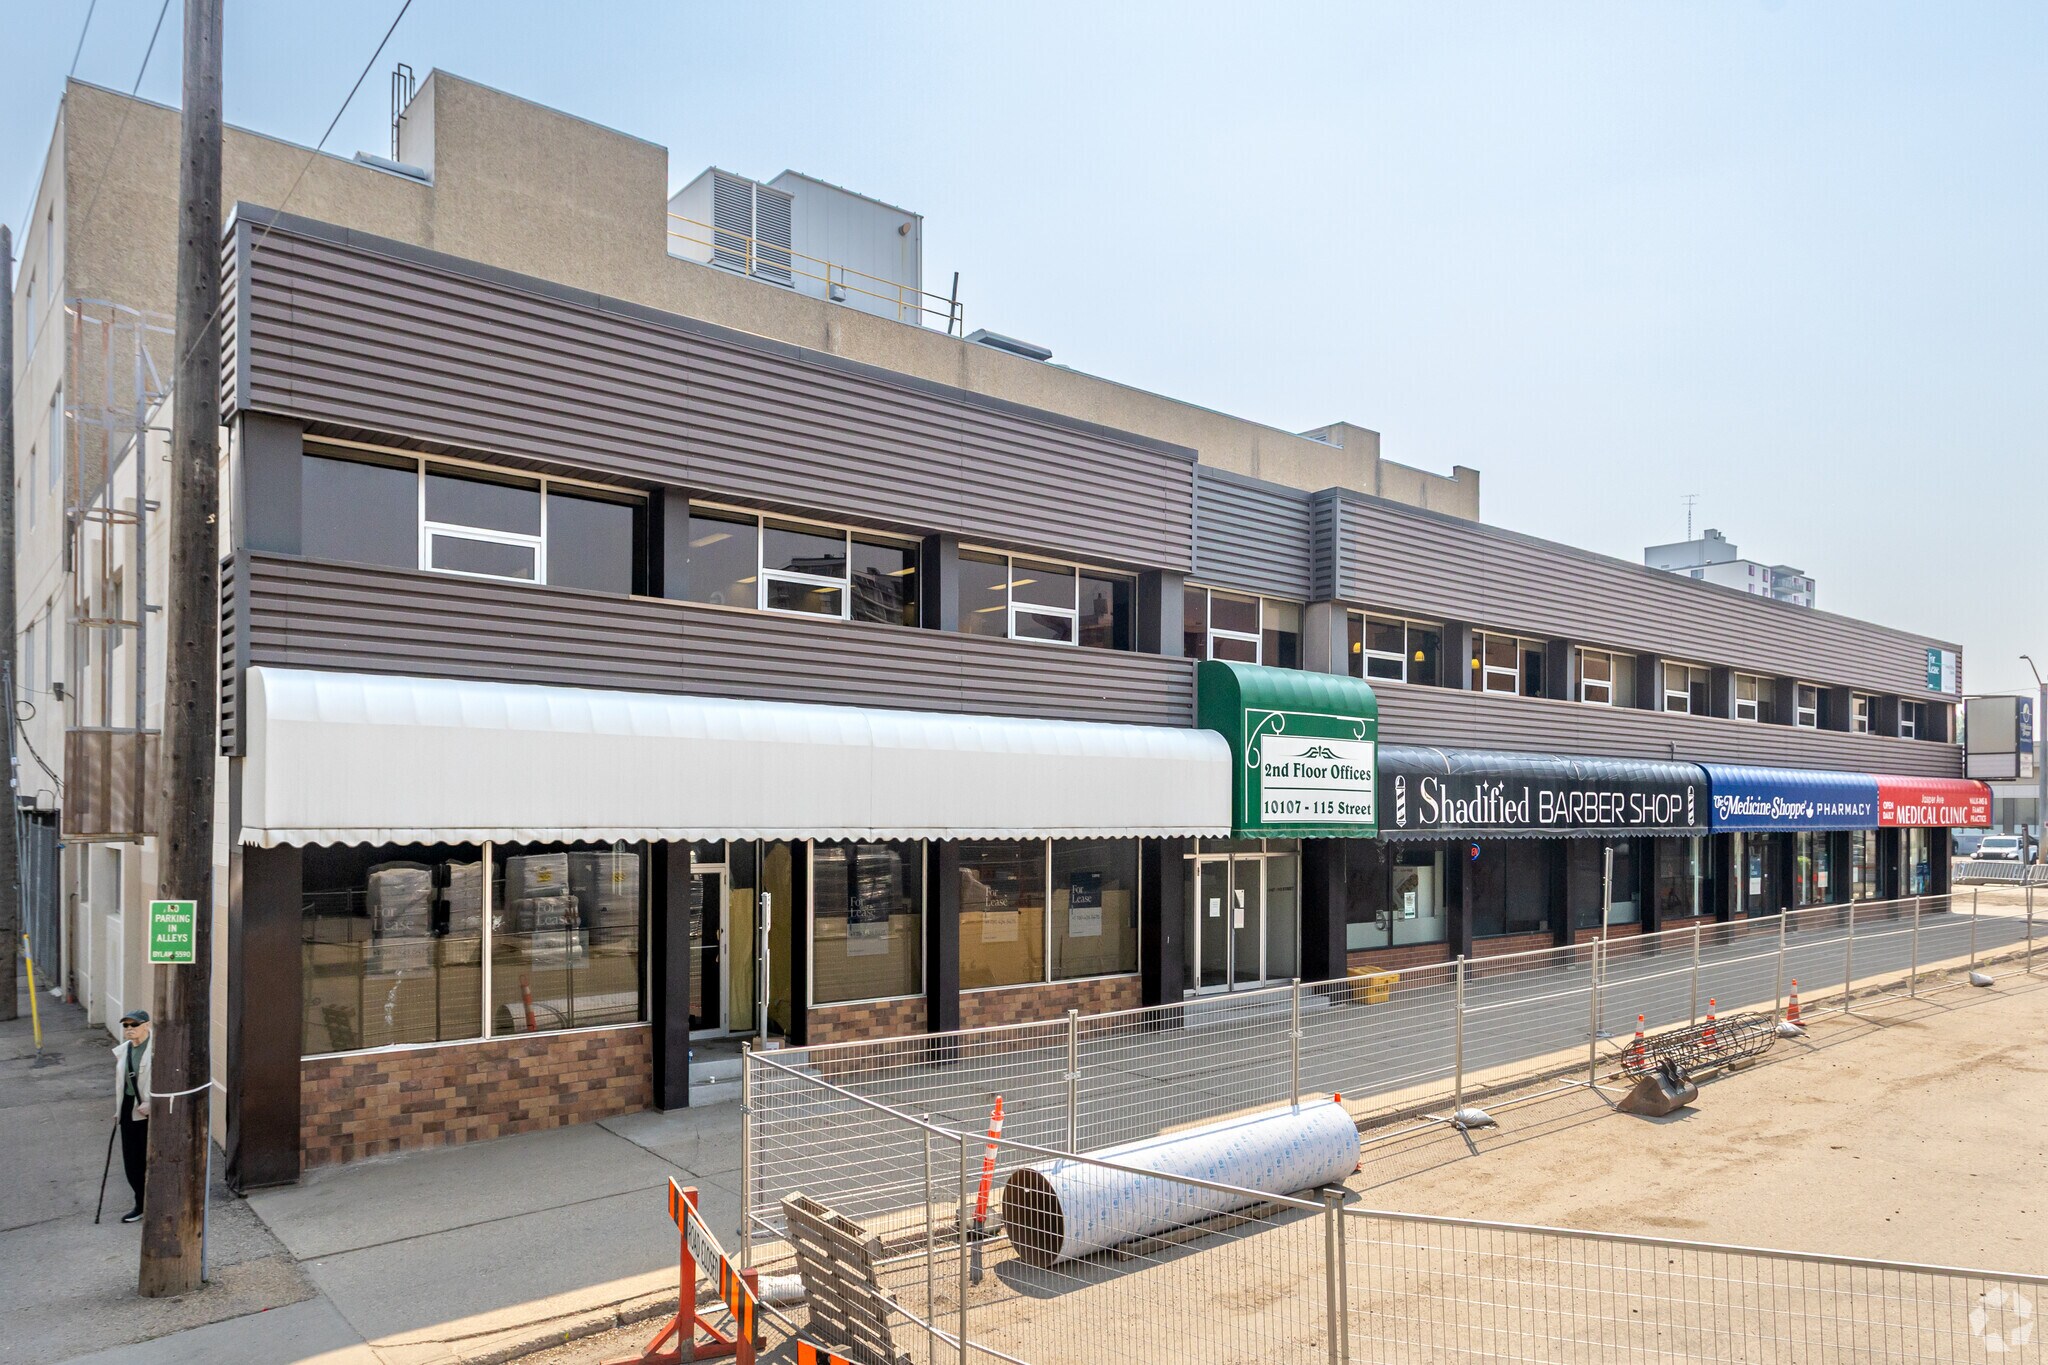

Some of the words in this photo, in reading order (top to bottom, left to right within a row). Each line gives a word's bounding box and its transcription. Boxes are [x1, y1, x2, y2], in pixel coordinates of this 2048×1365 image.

[1264, 762, 1289, 778] 2nd
[1293, 763, 1328, 779] Floor
[1330, 764, 1372, 781] Offices
[1419, 776, 1530, 824] Shadified
[1538, 790, 1625, 824] BARBER
[1629, 792, 1683, 824] SHOP
[1921, 794, 1936, 805] Jasper
[1936, 795, 1945, 804] Ave
[1264, 800, 1301, 814] 10107
[1313, 801, 1334, 814] 115
[1337, 801, 1372, 816] Street
[1713, 795, 1724, 808] The
[1719, 795, 1771, 820] Medicine
[1771, 796, 1807, 819] Shoppe
[1816, 802, 1871, 816] PHARMACY
[1882, 801, 1894, 810] OPEN
[1971, 806, 1985, 814] FAMILY
[1882, 811, 1894, 820] DAILY
[1896, 805, 1938, 825] MEDICAL
[1939, 806, 1968, 824] CLINIC
[1970, 815, 1987, 823] PRACTICE
[985, 886, 999, 897] For
[1072, 884, 1084, 894] For
[850, 896, 865, 907] For
[985, 897, 1008, 907] Lease
[1072, 894, 1092, 904] Lease
[167, 904, 180, 913] NO
[374, 905, 398, 918] For
[537, 900, 556, 913] For
[155, 914, 191, 923] PARKING
[167, 924, 178, 933] IN
[374, 918, 415, 931] Lease
[156, 933, 188, 943] ALLEYS
[152, 950, 173, 958] BYLAW
[688, 1220, 701, 1259] ROAD
[701, 1239, 719, 1285] CLOSED
